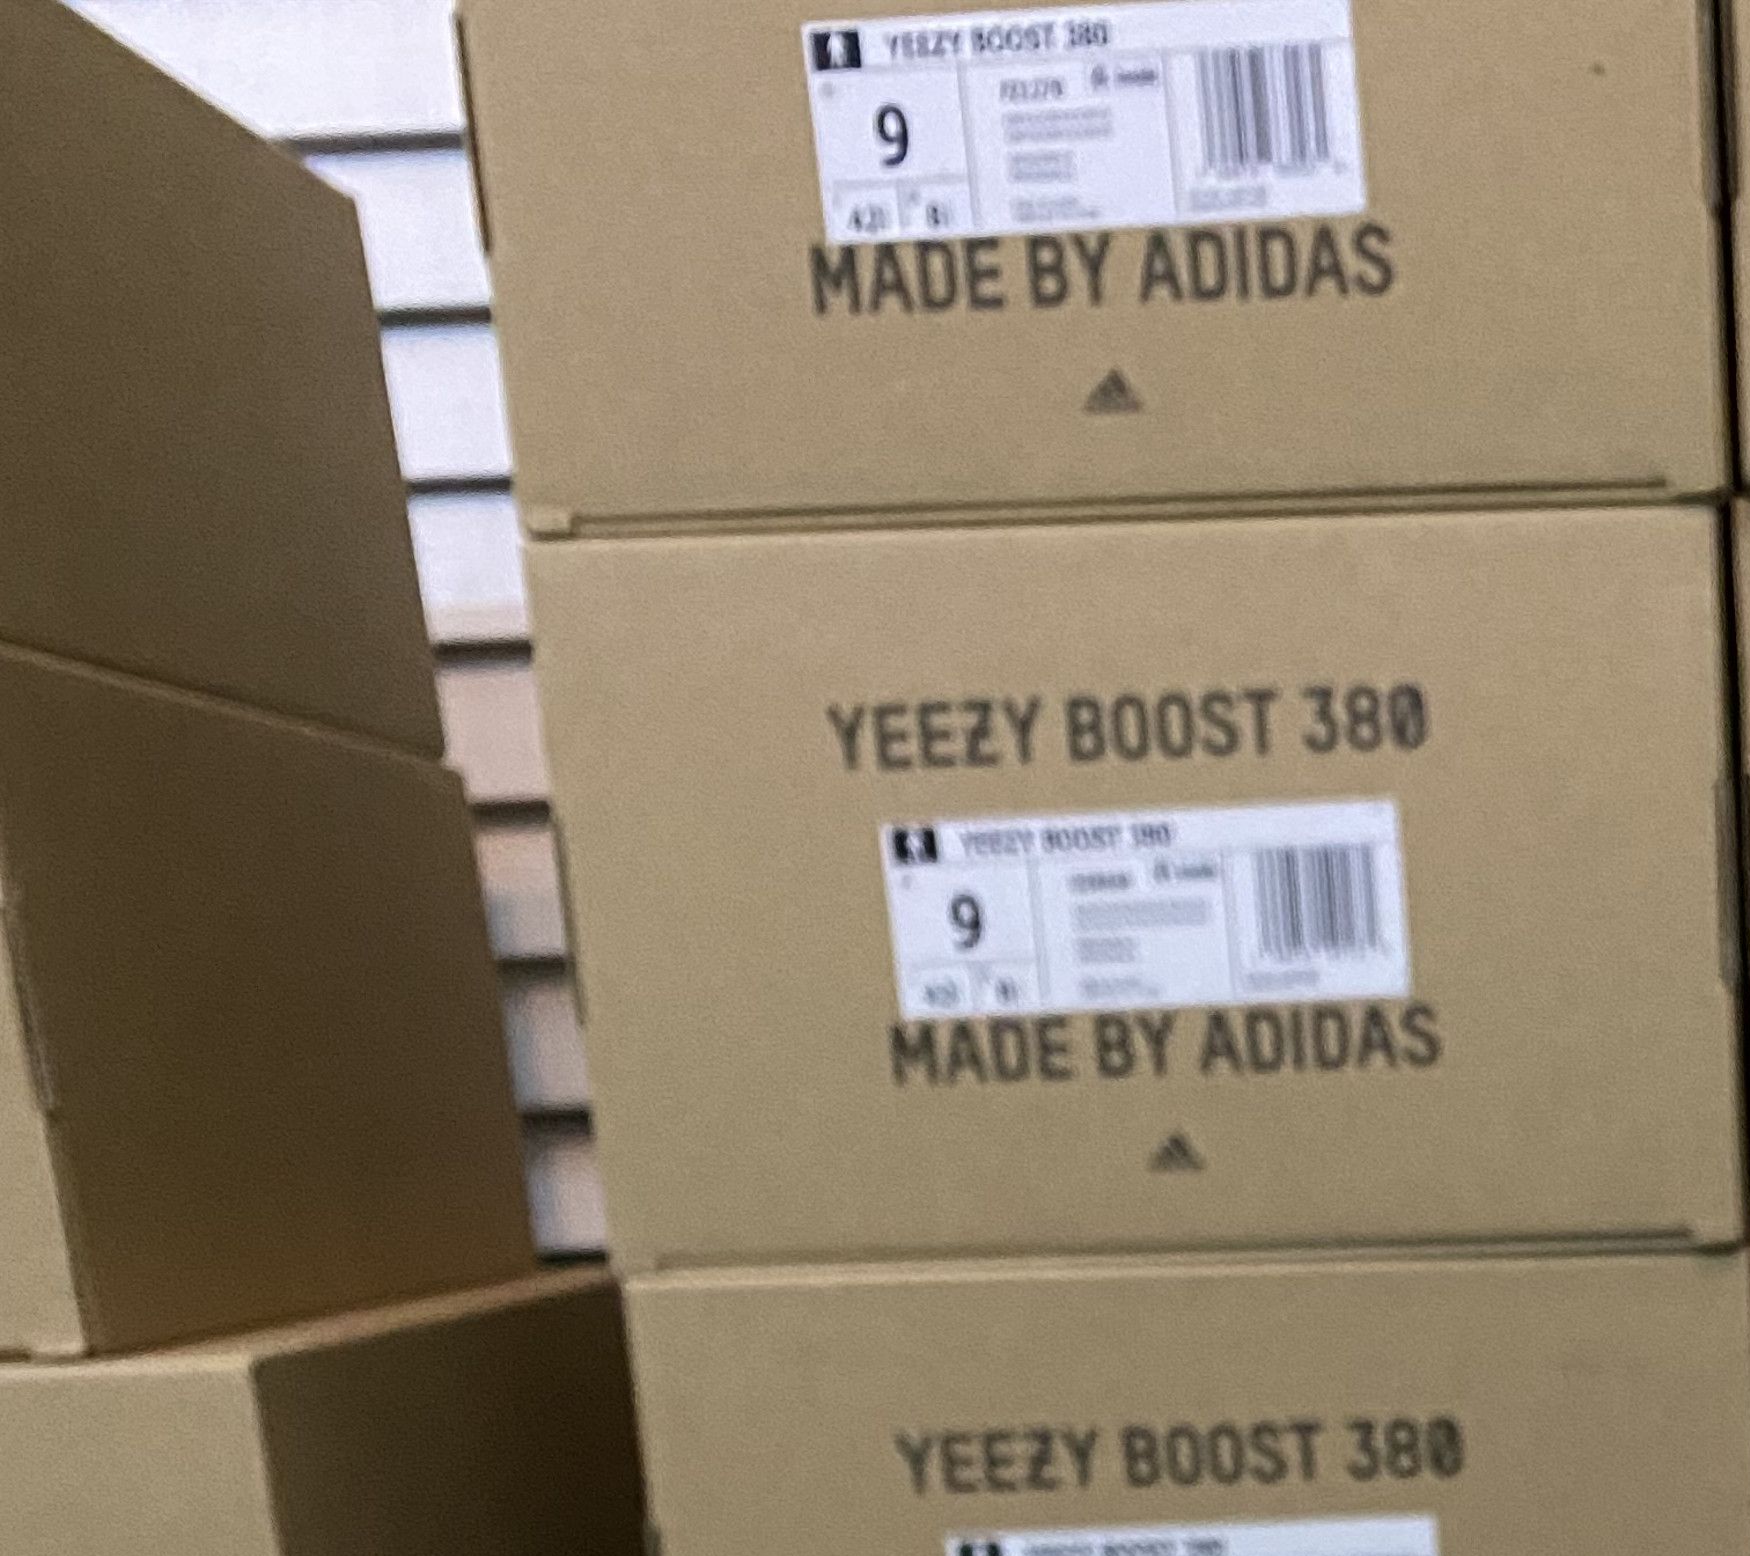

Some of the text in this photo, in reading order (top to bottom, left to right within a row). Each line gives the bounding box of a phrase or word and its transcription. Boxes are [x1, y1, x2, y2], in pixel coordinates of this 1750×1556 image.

[874, 101, 912, 169] 9
[808, 219, 1397, 317] MADE BY ADIDAS
[825, 681, 1431, 773] YEEZY BOOST 380
[948, 891, 986, 952] 9
[888, 1000, 1445, 1087] MADE BY ADIDAS
[894, 1412, 1467, 1497] YEEZY BOOST 380
